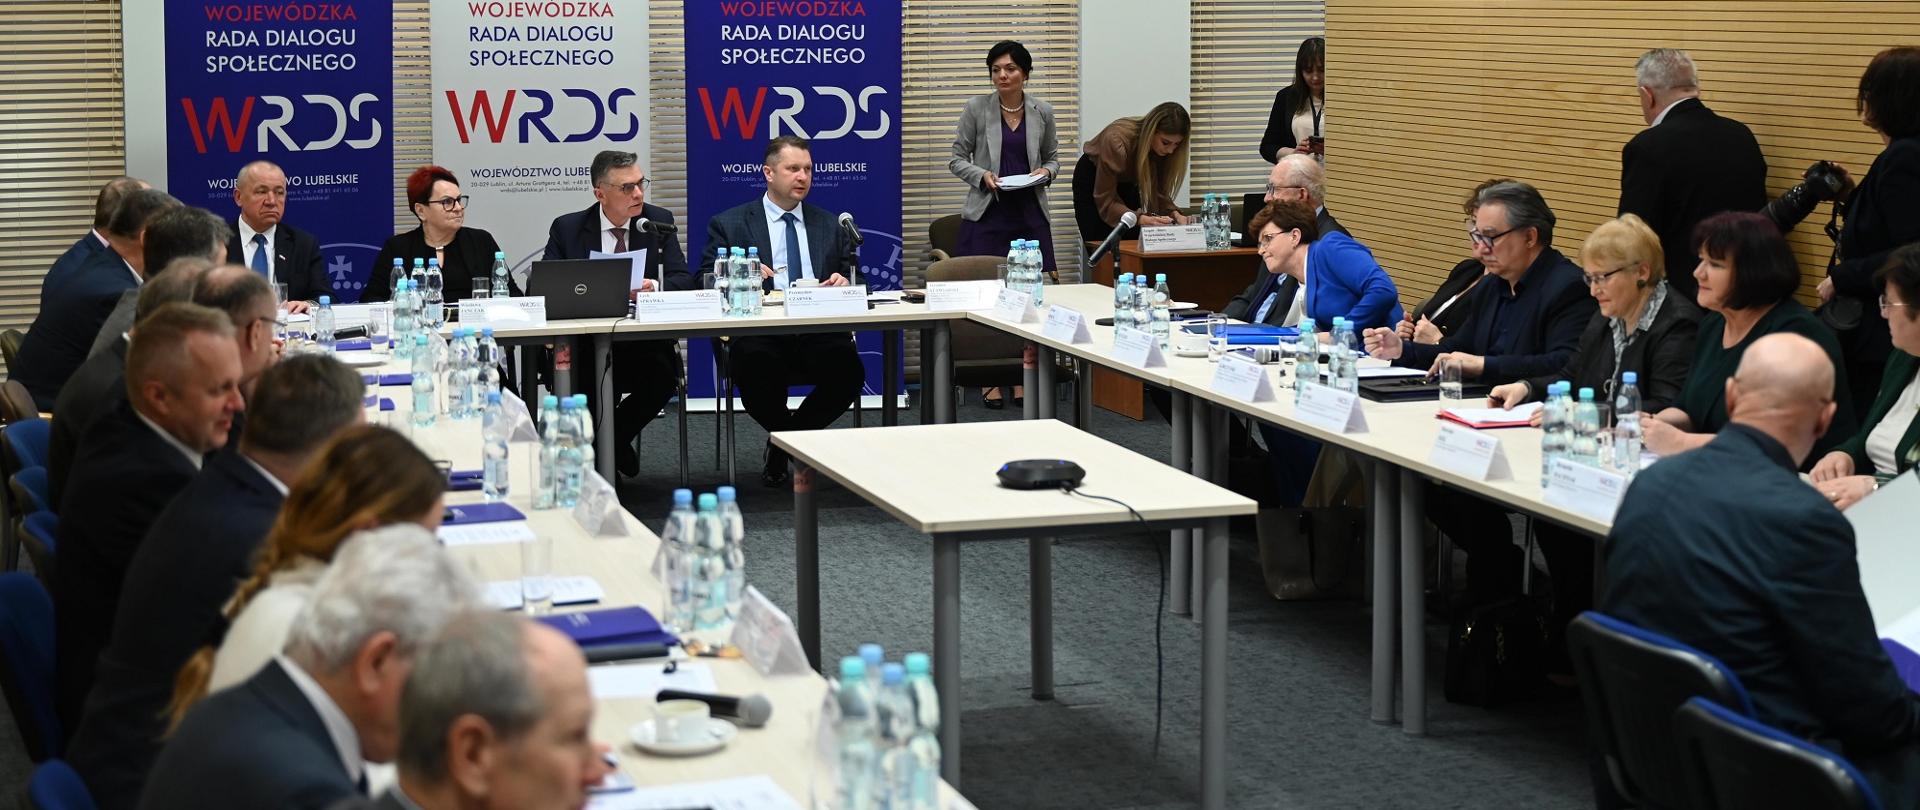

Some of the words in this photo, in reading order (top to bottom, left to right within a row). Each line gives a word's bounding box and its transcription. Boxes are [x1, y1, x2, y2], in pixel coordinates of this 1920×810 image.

[204, 1, 357, 22] WOJEWÓDZKA
[206, 29, 259, 48] RADA
[266, 28, 356, 47] DIALOGU
[469, 26, 520, 42] RADA
[527, 25, 614, 42] DIALOGU
[721, 25, 772, 41] RADA
[778, 24, 865, 41] DIALOGU
[206, 53, 356, 73] SPOŁECZNEGO
[469, 49, 614, 66] SPOŁECZNEGO
[721, 48, 866, 64] SPOŁECZNEGO
[445, 87, 639, 144] WRDS
[697, 85, 891, 140] WRDS
[182, 92, 382, 154] WRDS
[470, 166, 562, 178] WOJEWÓDZTWO
[815, 162, 867, 173] LUBELSKIE
[305, 174, 359, 185] LUBELSKIE
